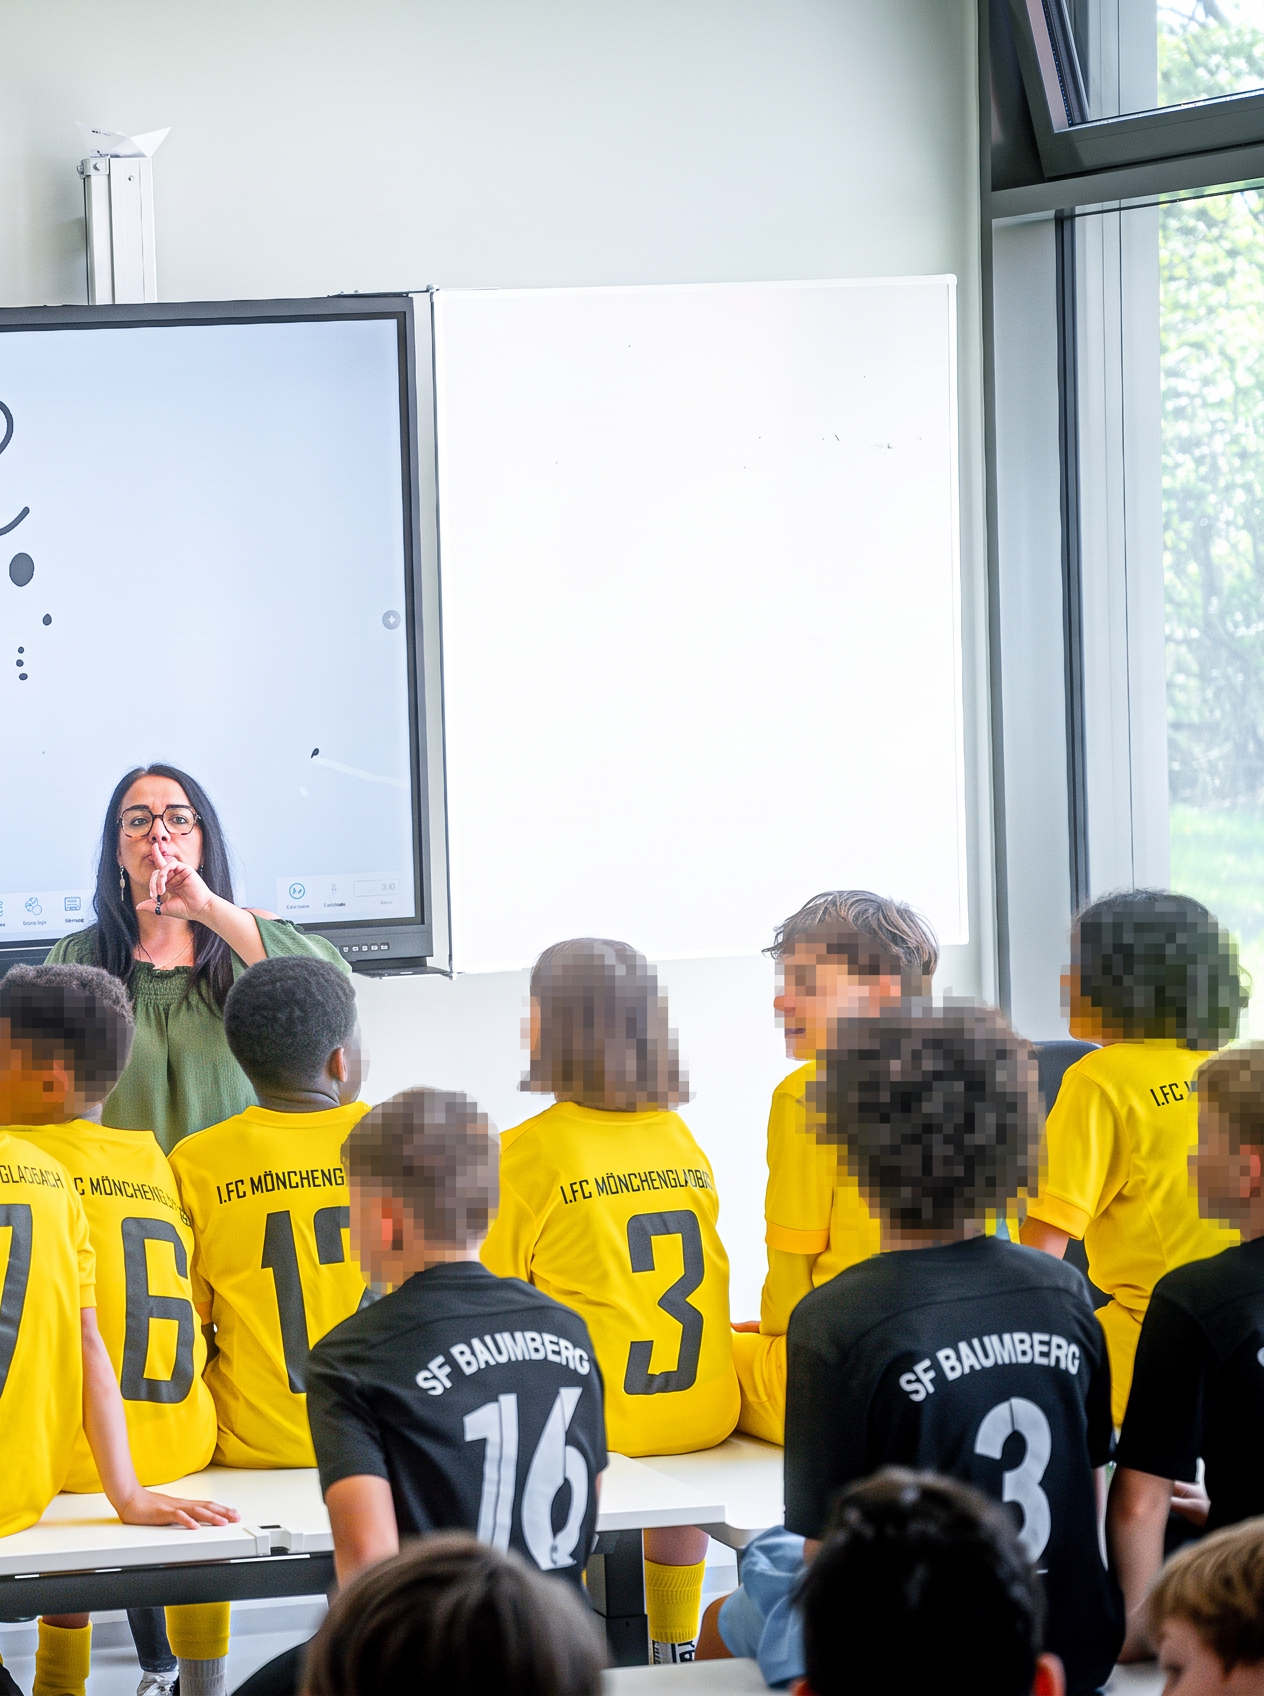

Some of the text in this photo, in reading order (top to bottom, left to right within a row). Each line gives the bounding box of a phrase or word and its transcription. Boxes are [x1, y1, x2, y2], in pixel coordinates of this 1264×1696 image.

[120, 1216, 195, 1404] 6
[415, 1329, 591, 1396] SF BAUMBERG
[623, 1209, 705, 1396] 3
[898, 1331, 1080, 1403] SF BAUMBERG
[463, 1386, 589, 1572] 16
[973, 1396, 1052, 1563] 3
